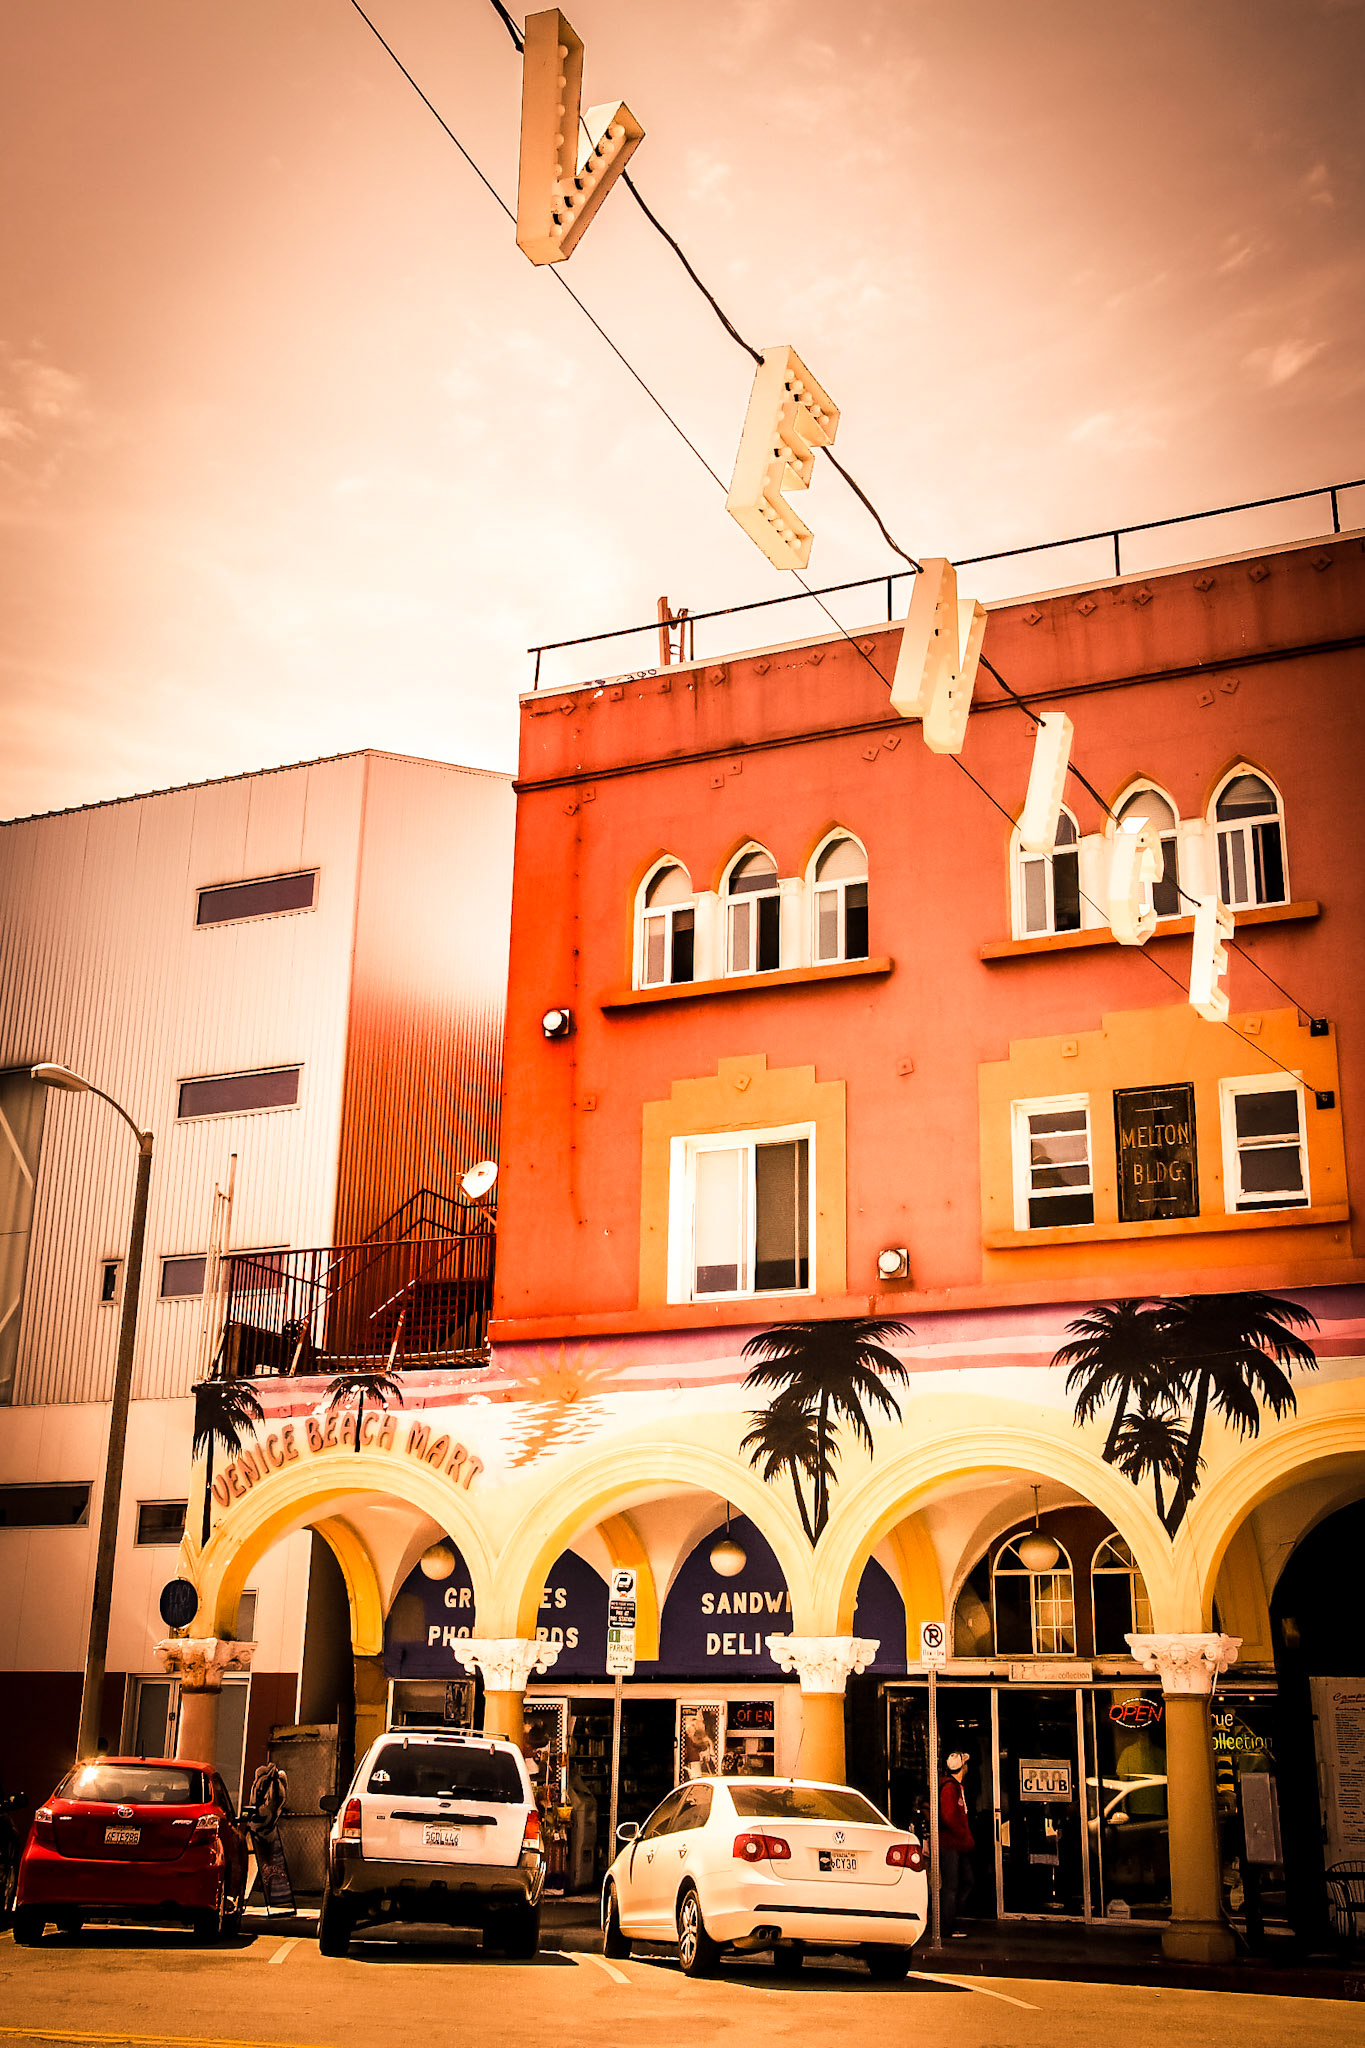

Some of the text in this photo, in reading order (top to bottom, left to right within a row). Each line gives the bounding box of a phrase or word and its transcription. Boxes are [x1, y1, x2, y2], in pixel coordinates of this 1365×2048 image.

[1122, 1122, 1190, 1150] MELTON
[211, 1411, 485, 1508] VENICE BEACH MART
[1108, 1703, 1163, 1722] OPEN
[1023, 1779, 1069, 1792] CLUB
[1028, 1770, 1063, 1783] PRO
